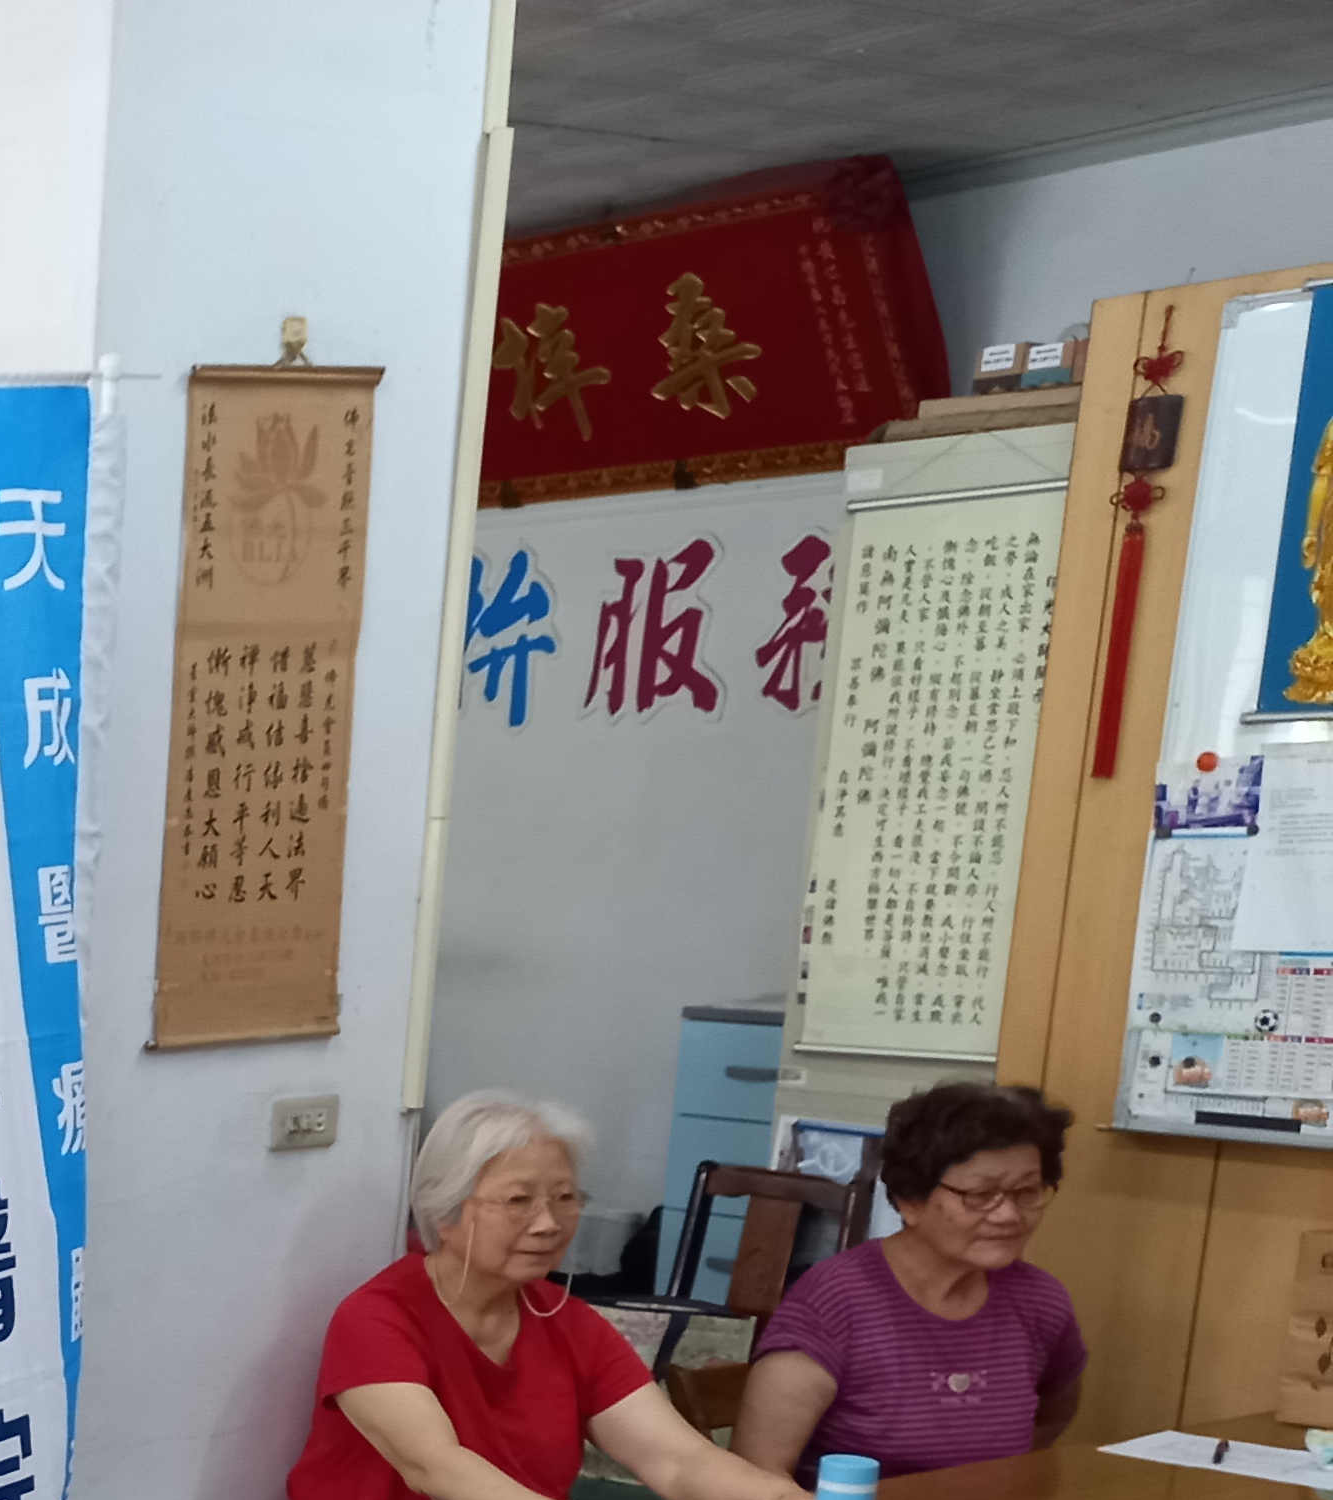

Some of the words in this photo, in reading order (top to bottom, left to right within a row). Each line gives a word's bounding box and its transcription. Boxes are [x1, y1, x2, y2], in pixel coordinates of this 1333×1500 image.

[868, 543, 899, 683] 南無阿彌陀佛
[195, 645, 232, 900] 慚愧感恩大願心
[256, 644, 290, 902] 惜福結緣利人天
[285, 640, 317, 901] 慈悲喜捨遍法界
[854, 717, 880, 805] 阿彌陀佛
